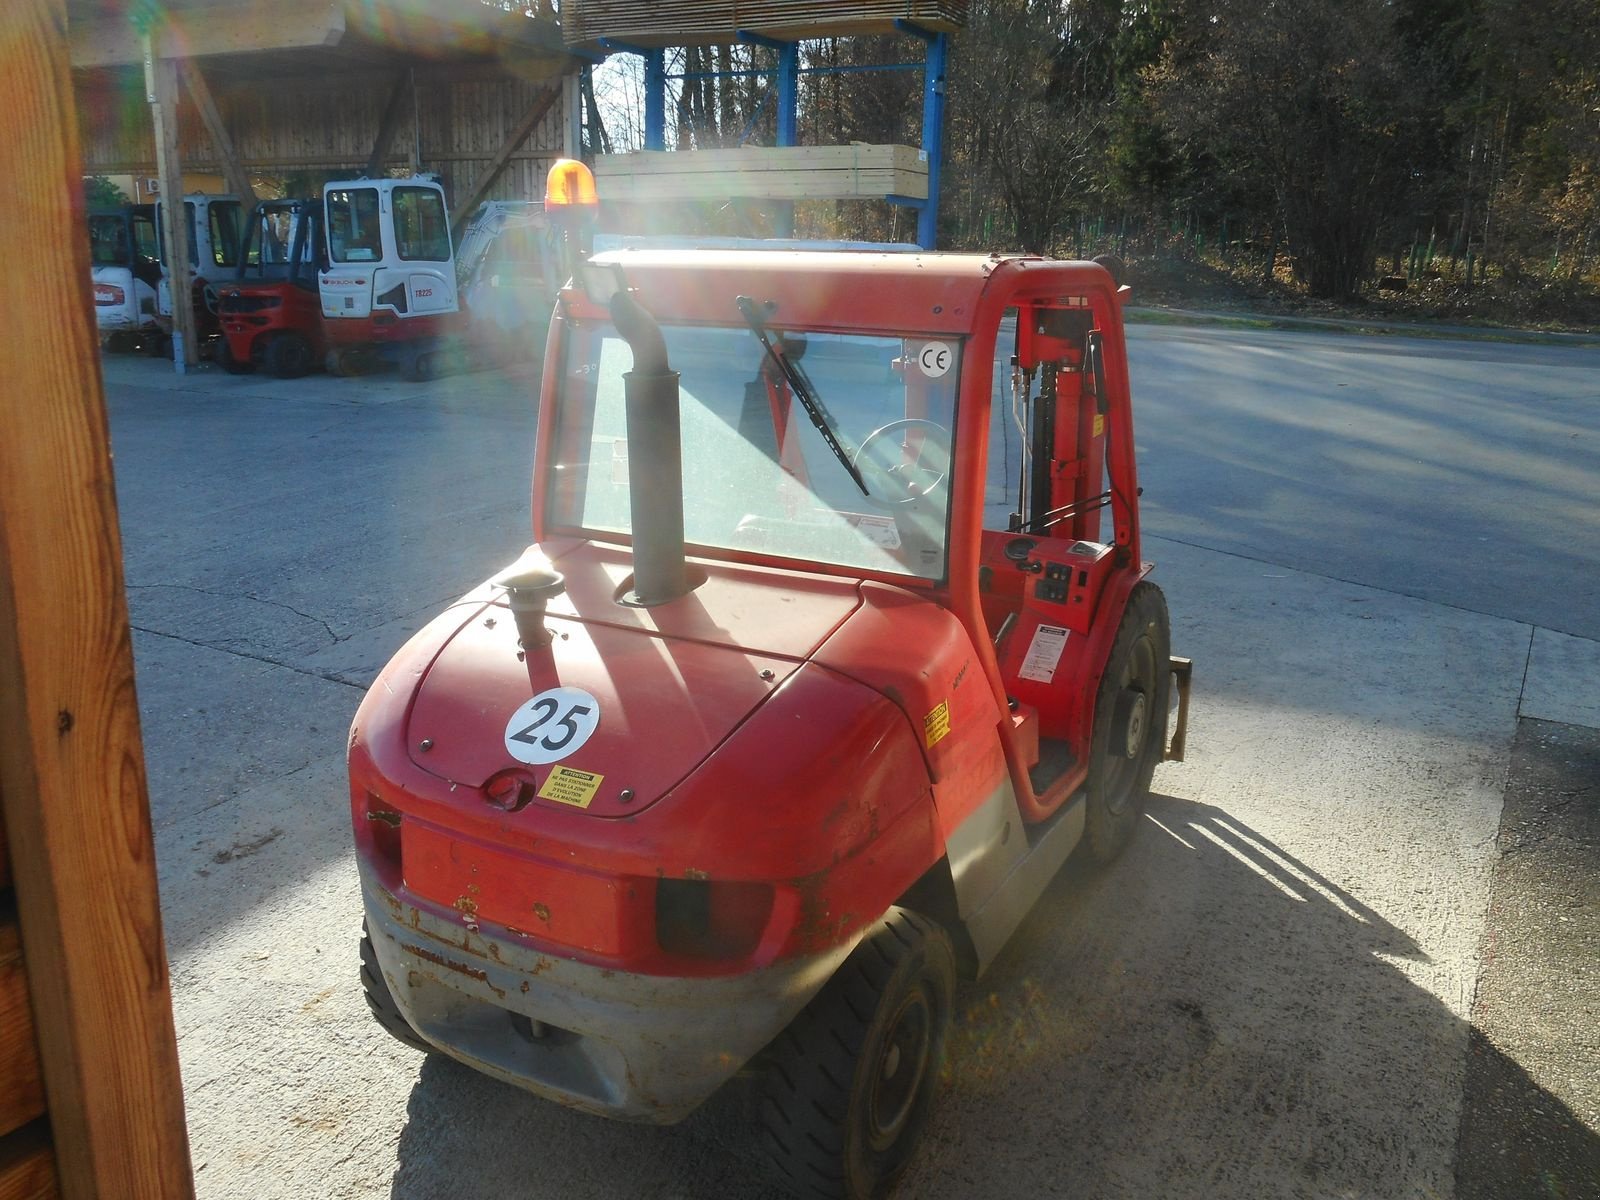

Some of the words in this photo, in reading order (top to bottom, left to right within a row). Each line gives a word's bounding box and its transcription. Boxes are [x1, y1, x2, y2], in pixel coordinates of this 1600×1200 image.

[922, 349, 947, 370] CE
[509, 697, 592, 751] 25
[563, 770, 591, 780] ATTENTION
[560, 795, 582, 803] MACHINE
